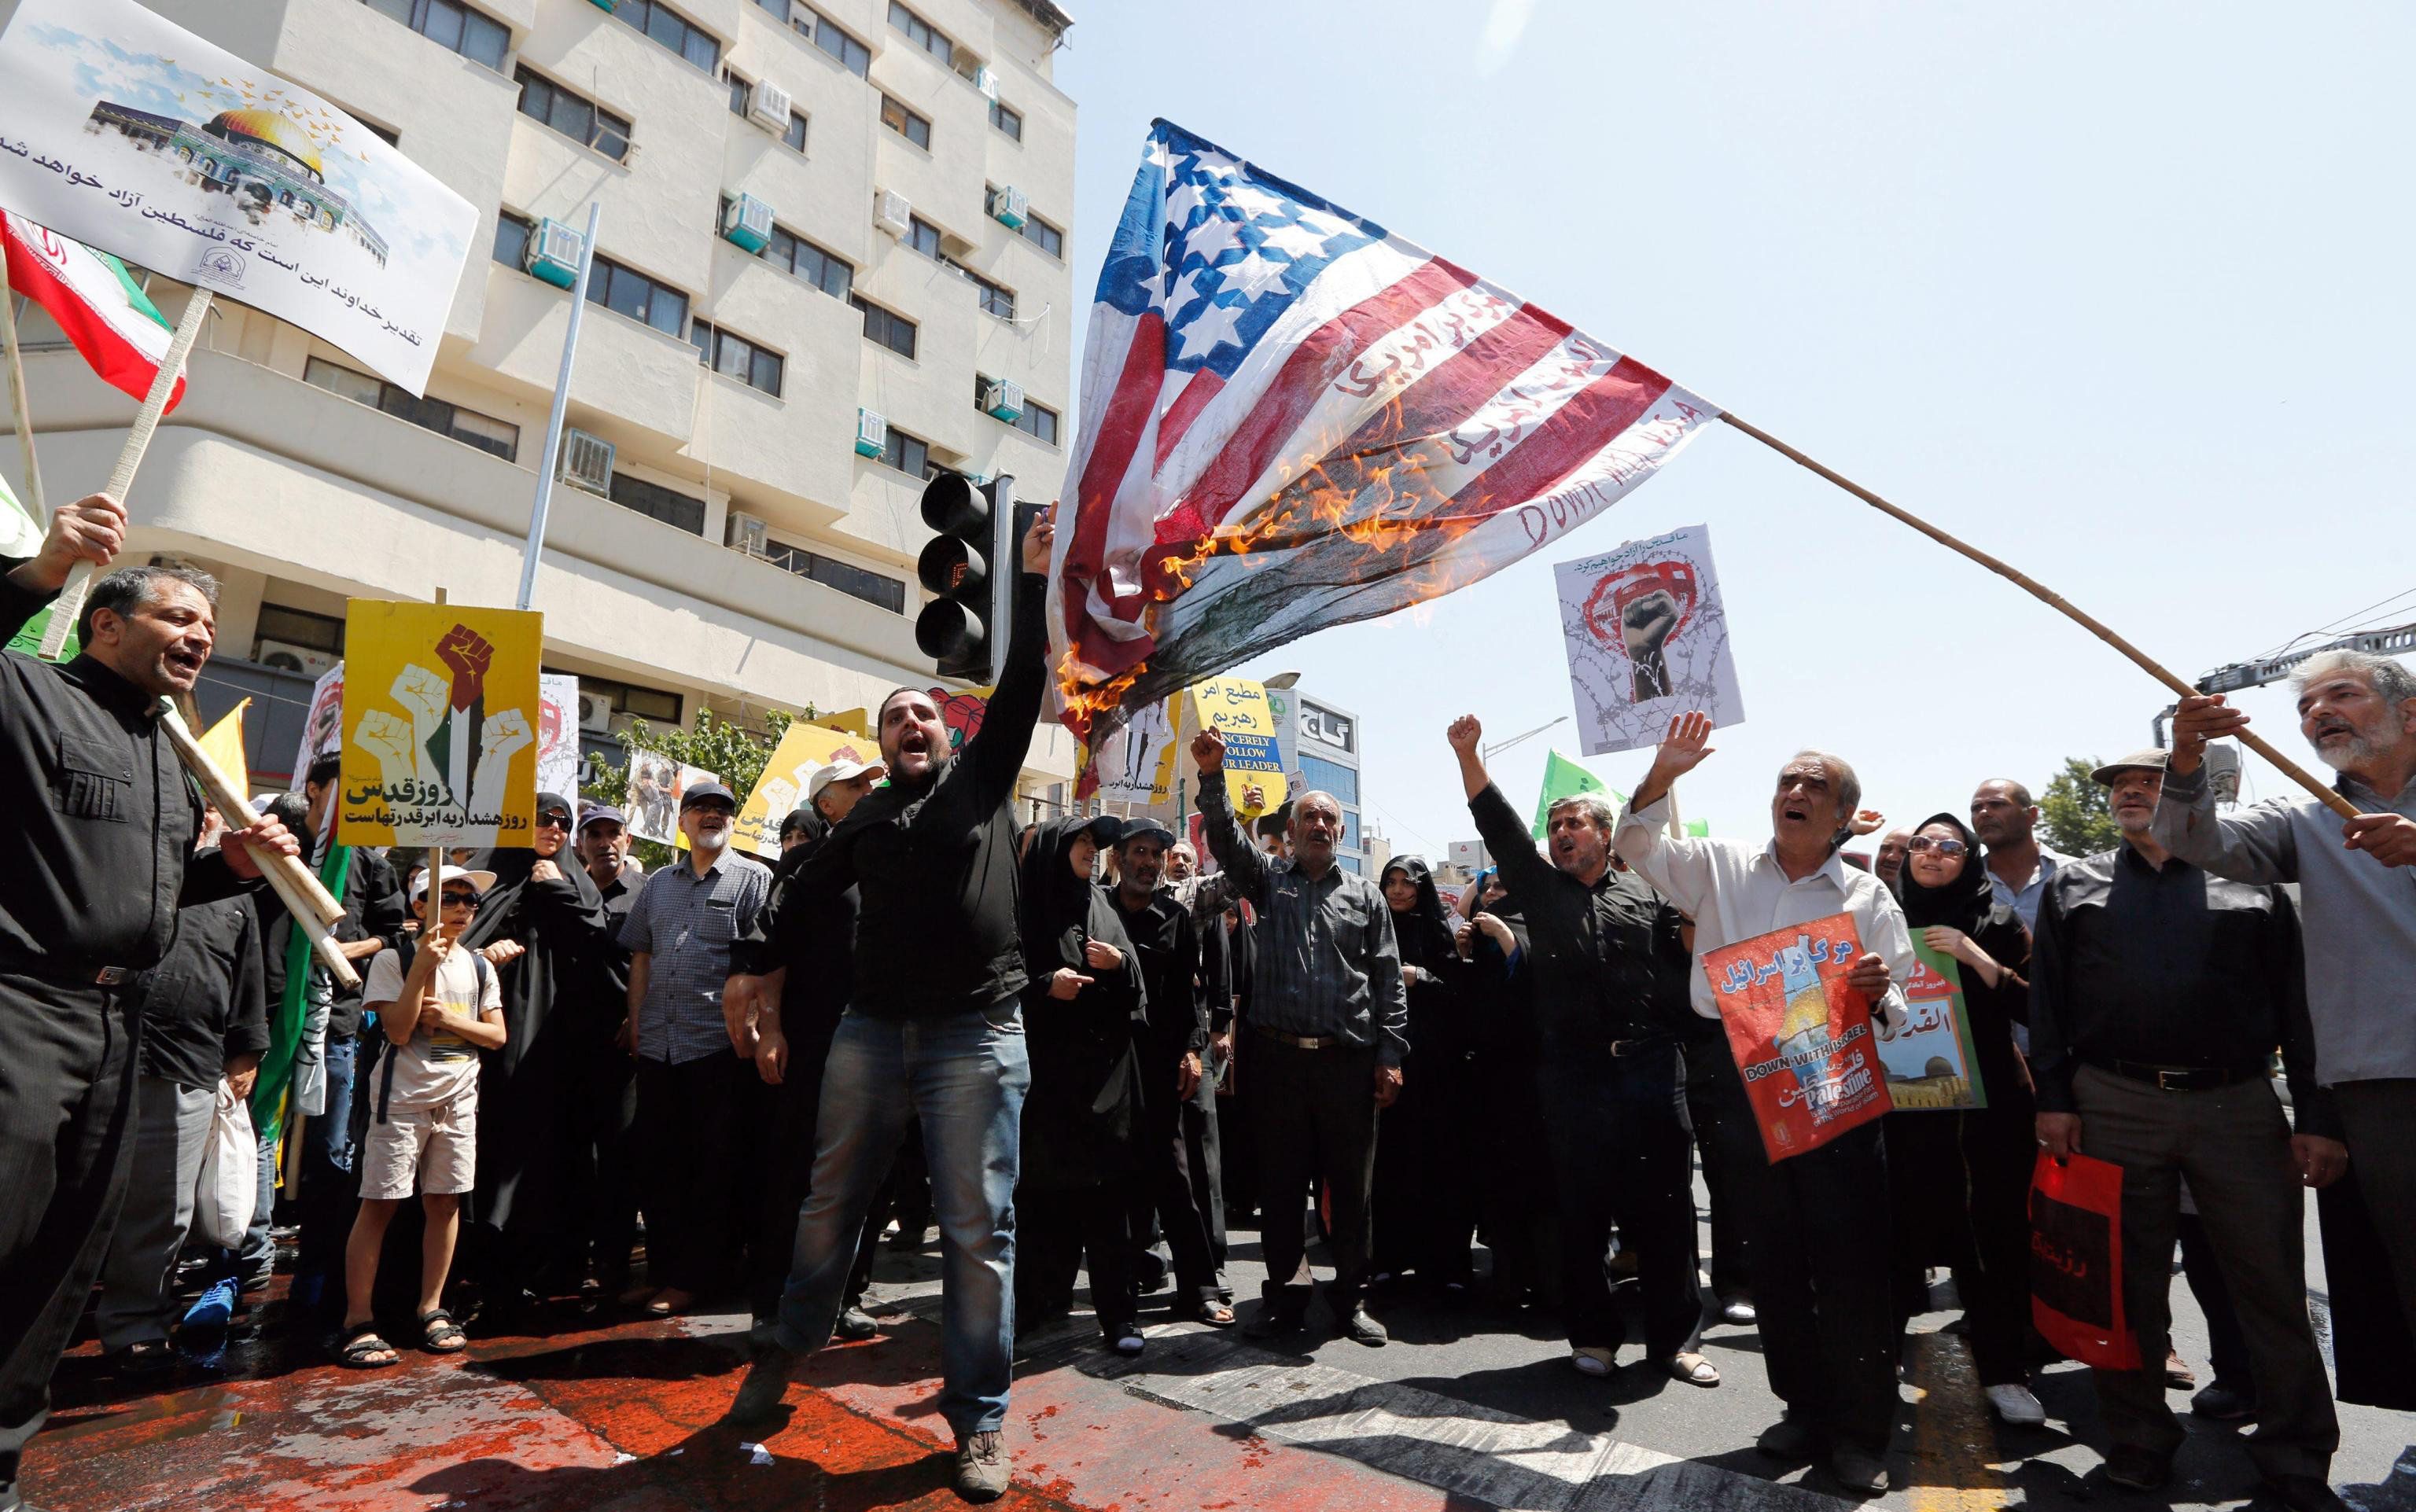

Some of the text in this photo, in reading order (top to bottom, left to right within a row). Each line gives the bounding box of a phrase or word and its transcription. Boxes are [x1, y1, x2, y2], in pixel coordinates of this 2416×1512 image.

[32, 156, 104, 189] خواهد
[109, 189, 145, 208] آزاد
[141, 206, 225, 241] فلسطین
[230, 237, 256, 252] که
[258, 248, 300, 273] است
[300, 272, 329, 289] این
[331, 285, 384, 321] خداوند
[381, 318, 422, 347] تقدیر
[1443, 312, 1475, 348] بر
[1646, 535, 1675, 550] قدس
[1676, 532, 1689, 541] ما
[1624, 544, 1638, 557] آزاد
[1639, 544, 1645, 553] را
[1590, 554, 1623, 571] خواهیم
[1202, 682, 1260, 704] مطیع امر
[1212, 711, 1258, 729] رهبریم
[1222, 734, 1270, 747] NCERELY
[1227, 746, 1266, 758] OLLOW
[1222, 759, 1281, 772] UR LEADER
[346, 777, 454, 807] روز قدس
[1152, 785, 1167, 794] روز
[443, 811, 459, 828] به
[459, 810, 503, 829] هشدار
[502, 815, 528, 830] روز
[1722, 937, 1854, 994] مرگ بر اسرائیل
[1744, 1024, 1868, 1083] DOWN WITH ISRAEL
[1779, 1048, 1865, 1108] فلسطین
[1806, 1068, 1873, 1110] Palestine
[1814, 1118, 1822, 1127] of
[1833, 1105, 1855, 1120] World
